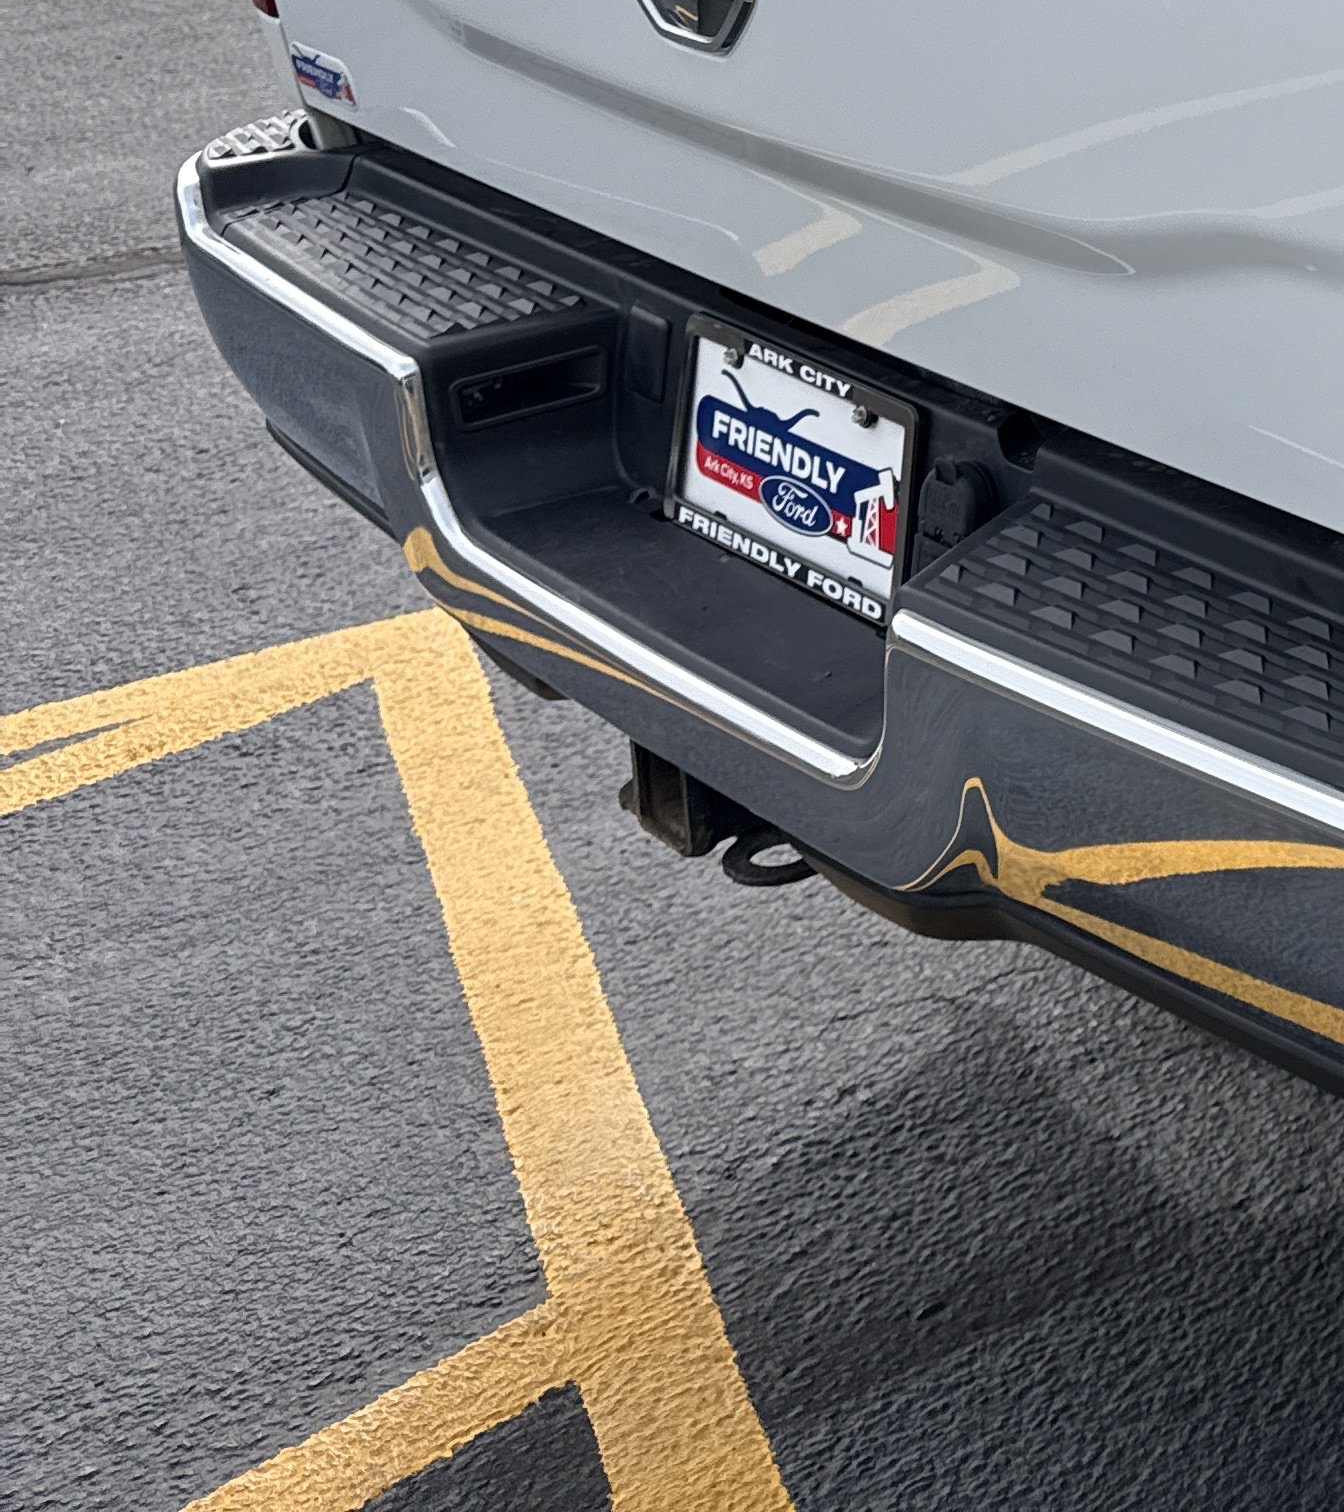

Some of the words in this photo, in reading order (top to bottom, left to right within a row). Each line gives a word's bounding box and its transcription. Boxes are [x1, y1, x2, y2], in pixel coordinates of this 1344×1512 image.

[747, 343, 795, 375] ARK
[799, 365, 851, 398] CITY
[712, 409, 846, 494] FRIENDLY
[772, 481, 817, 528] Ford
[678, 507, 802, 580] FRIENDLY
[807, 572, 882, 620] FORD
